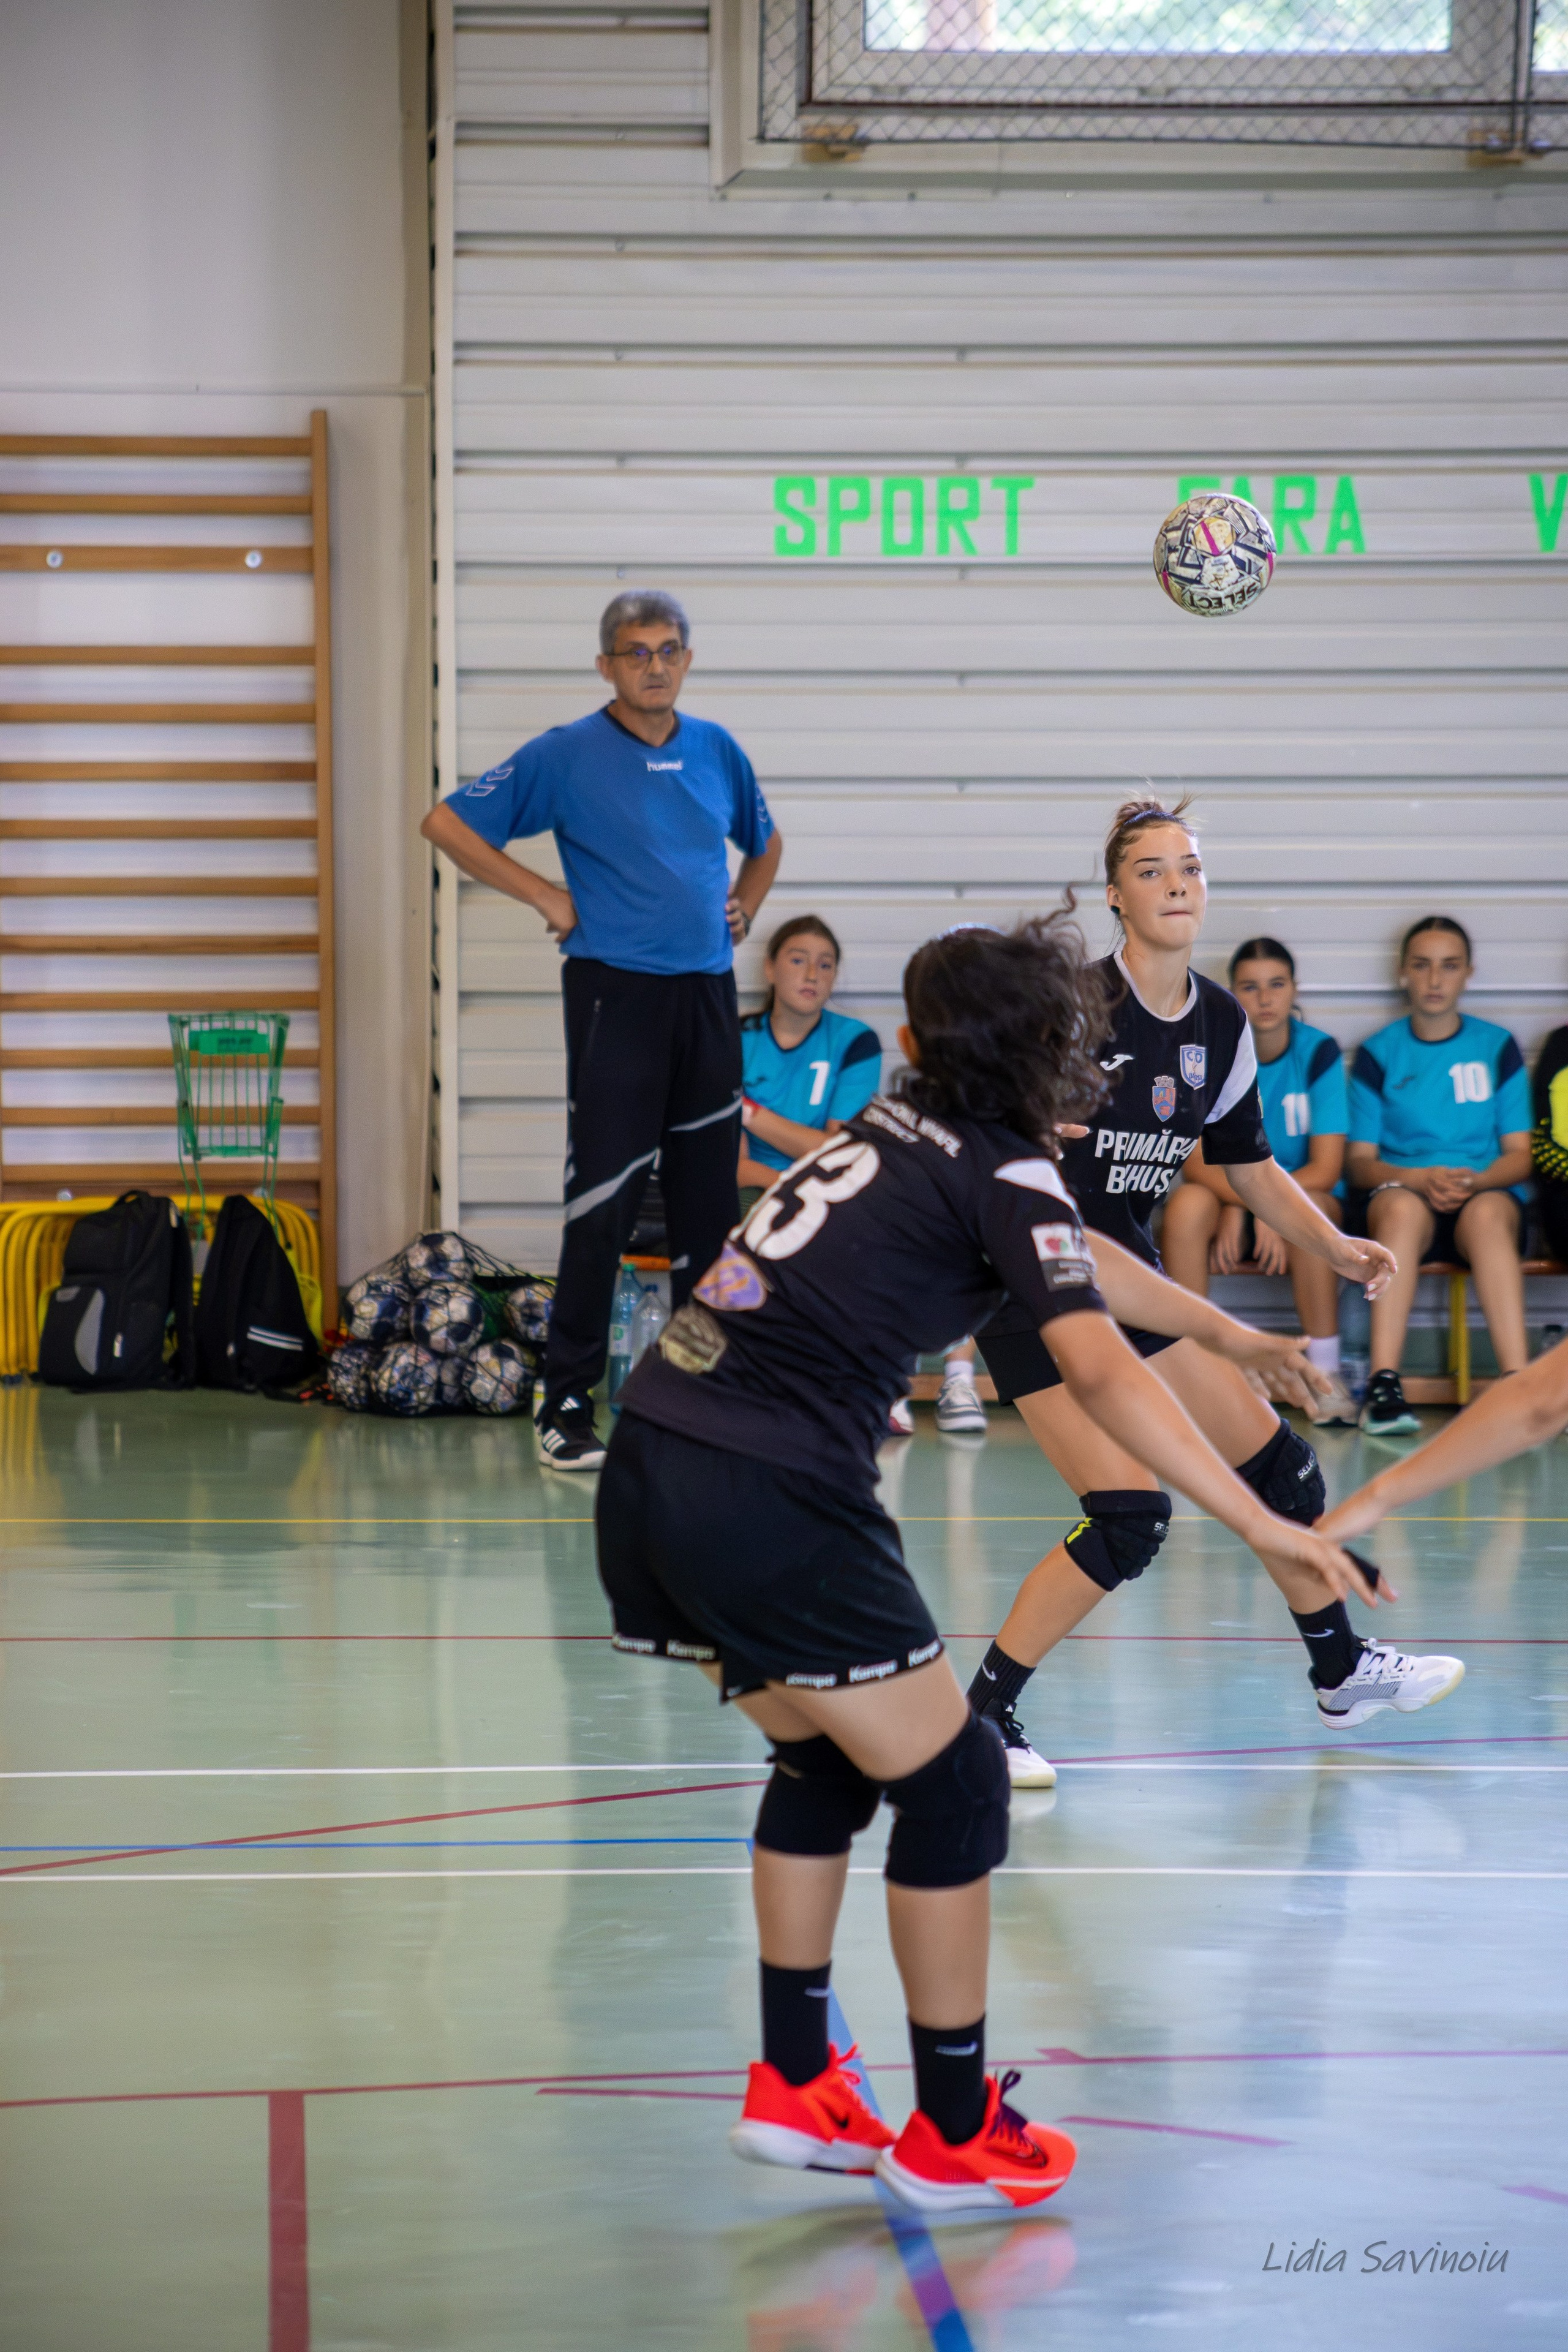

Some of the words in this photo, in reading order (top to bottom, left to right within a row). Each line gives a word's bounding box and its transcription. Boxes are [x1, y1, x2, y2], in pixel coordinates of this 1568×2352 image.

[774, 475, 1035, 556] SPORT
[1189, 582, 1259, 609] SELECT
[809, 1060, 830, 1106] 1
[1449, 1061, 1493, 1104] 10
[1282, 1093, 1310, 1137] 11
